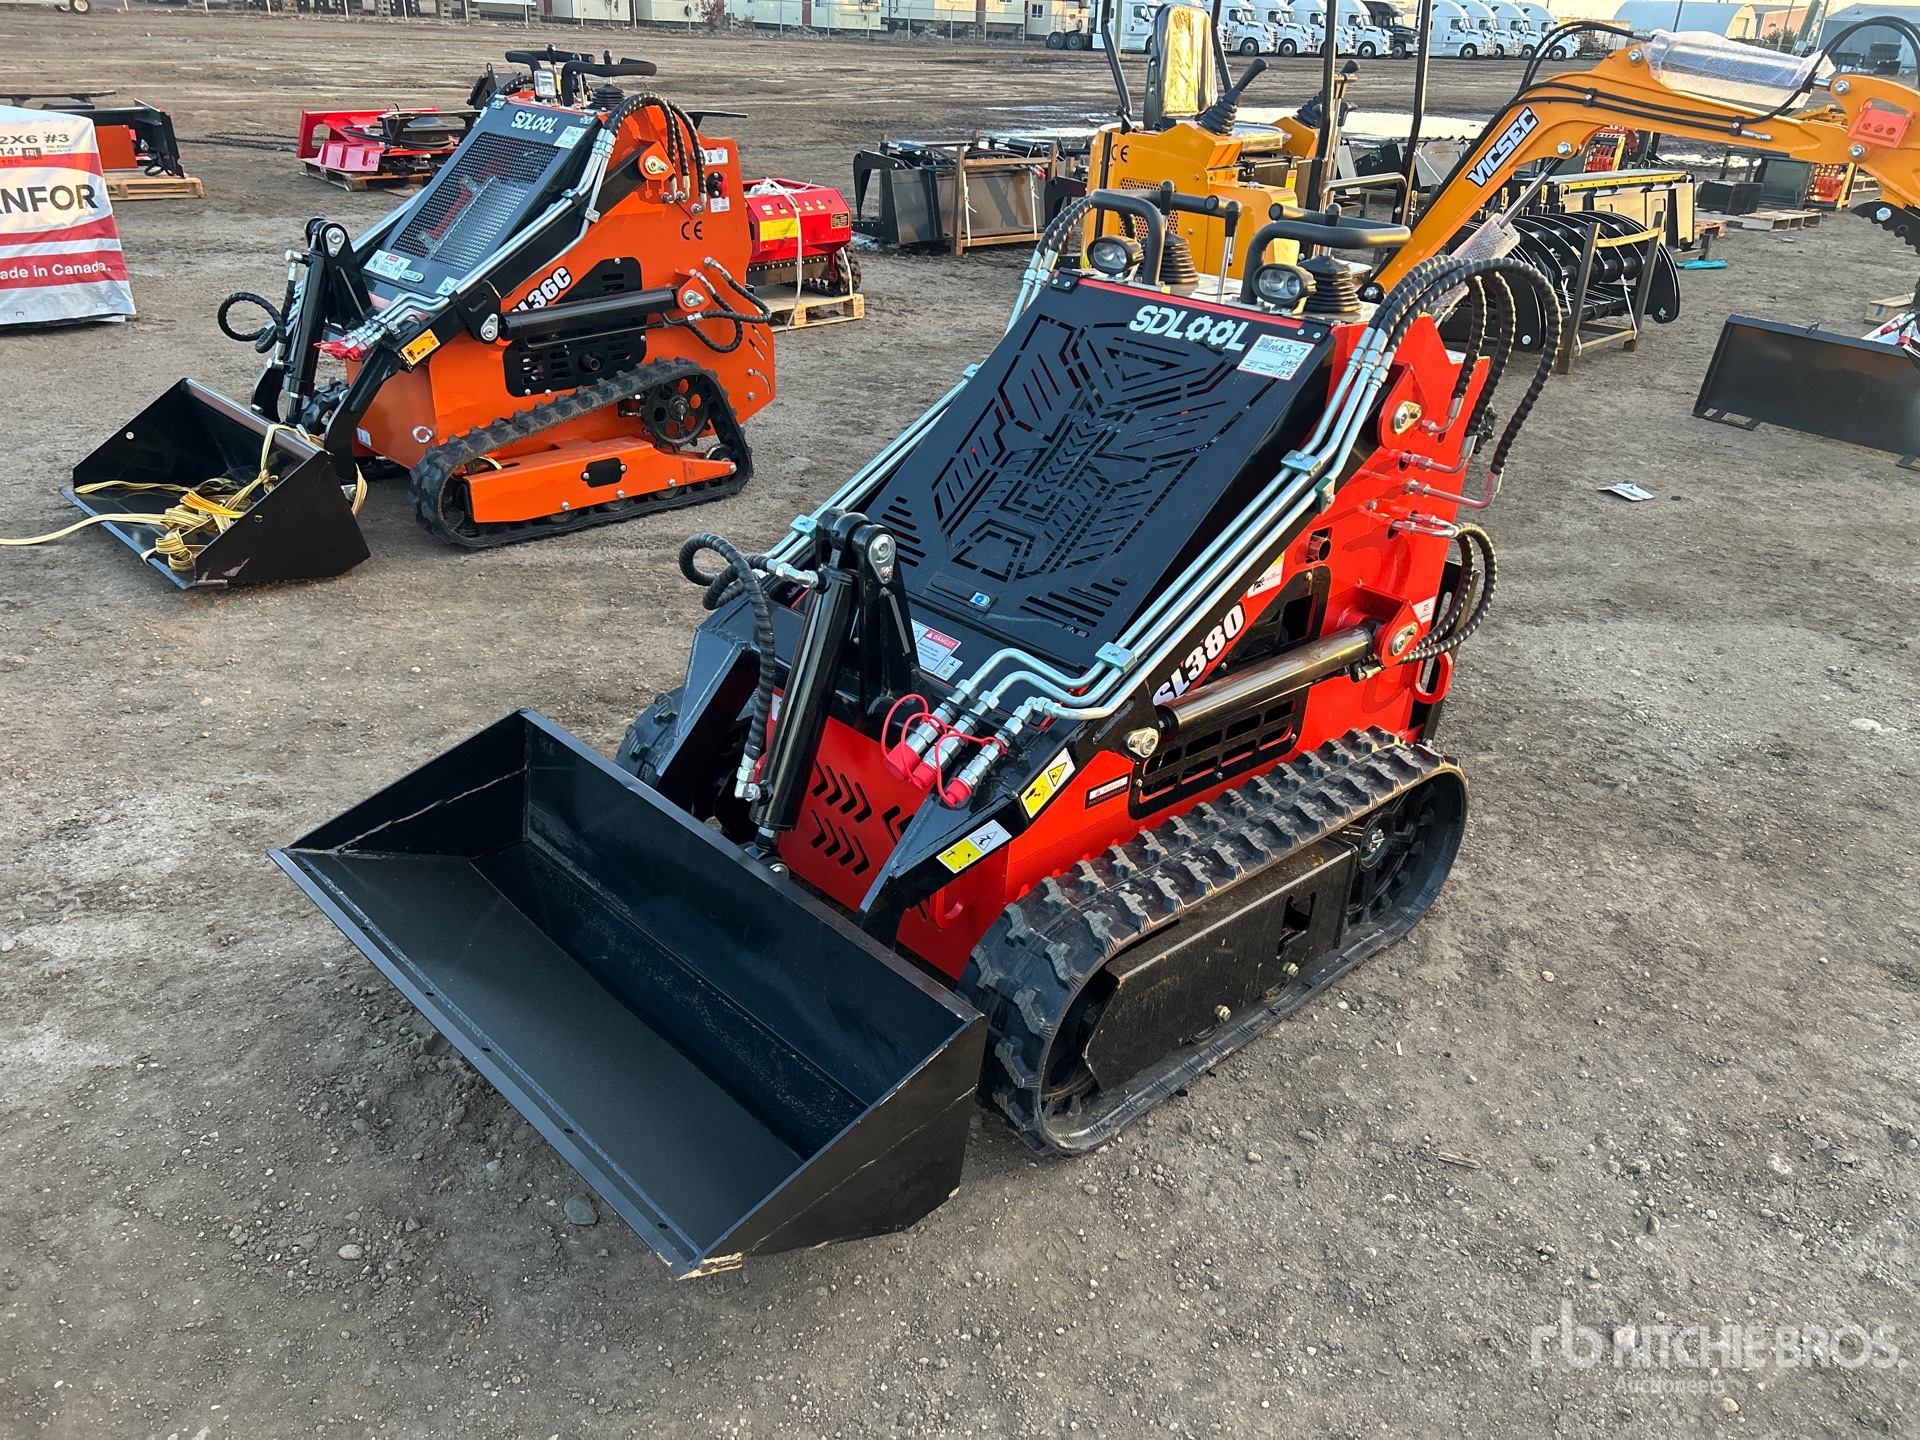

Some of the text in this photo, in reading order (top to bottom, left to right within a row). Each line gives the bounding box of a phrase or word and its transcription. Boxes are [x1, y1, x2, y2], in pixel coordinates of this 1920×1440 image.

[511, 111, 558, 134] SDLOOL
[44, 133, 70, 144] #3
[1465, 106, 1539, 188] VICSEC
[1111, 144, 1129, 163] CE
[0, 184, 99, 214] NFOR
[681, 220, 703, 241] CE
[33, 265, 48, 277] in
[52, 261, 112, 276] Canada.
[1129, 304, 1249, 352] SDLOOL
[1152, 603, 1247, 706] SL380
